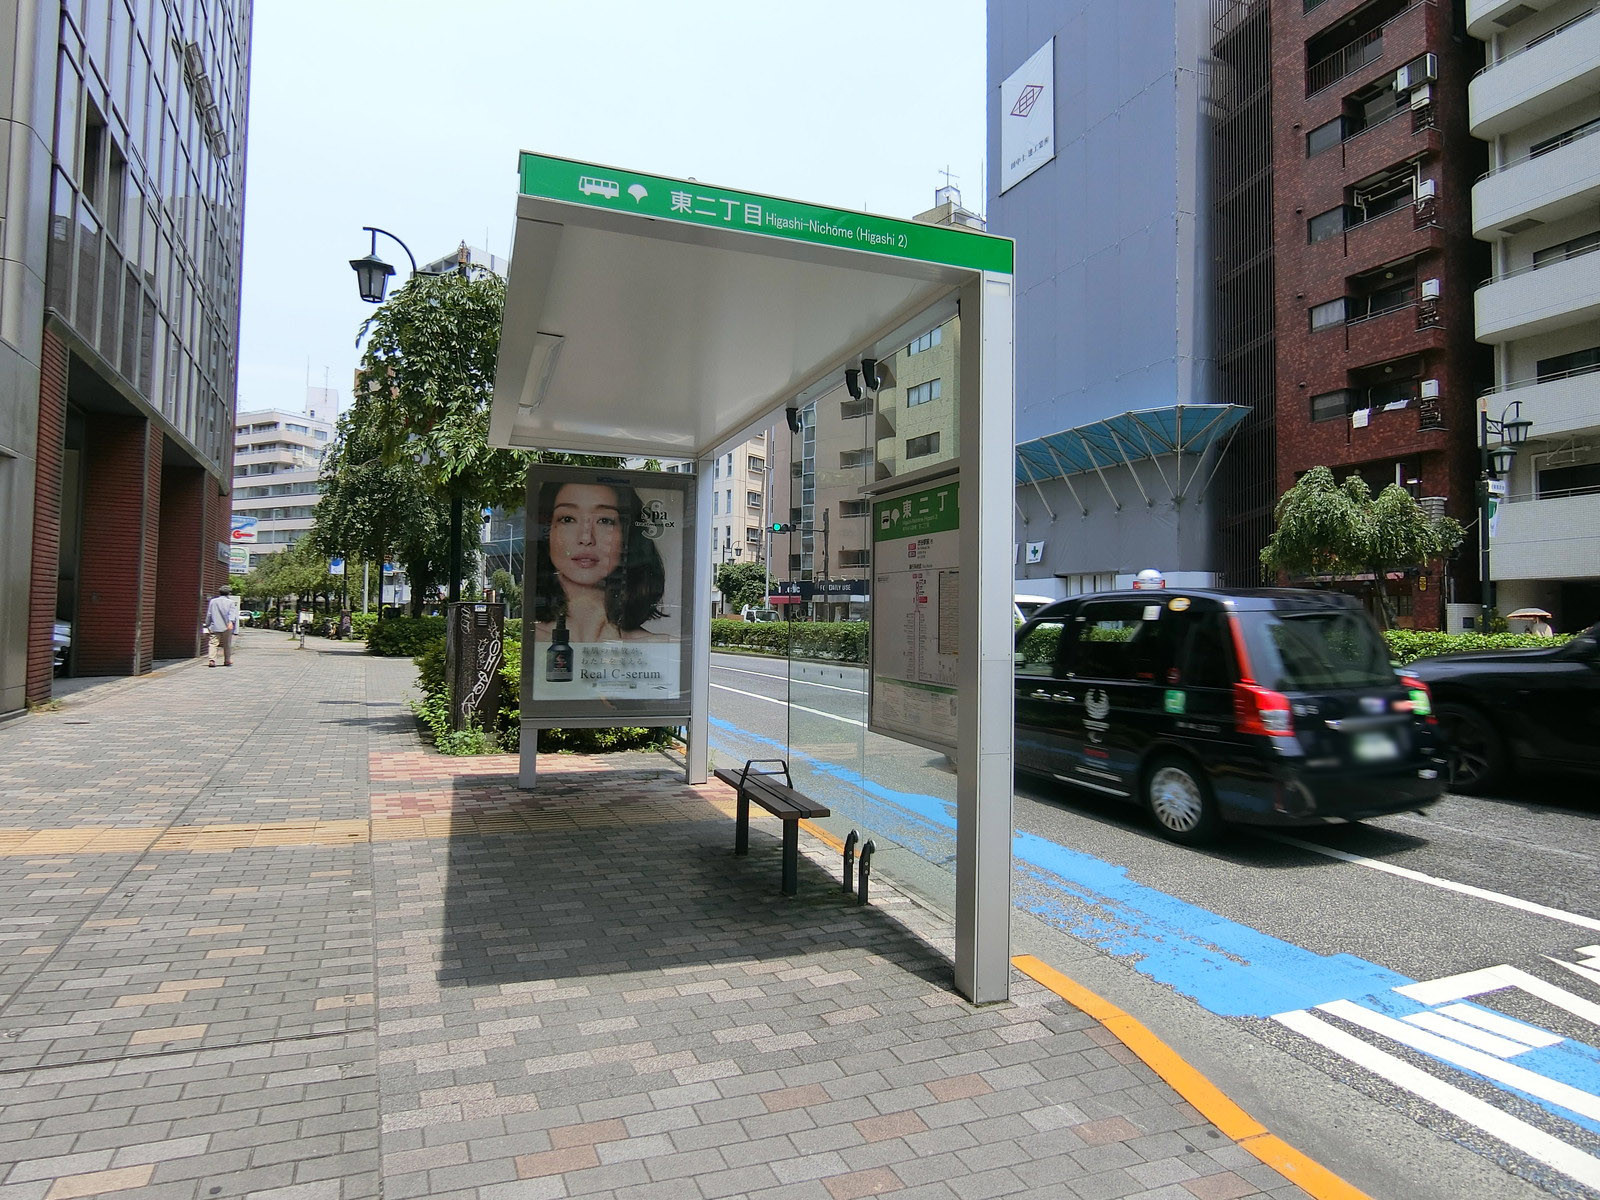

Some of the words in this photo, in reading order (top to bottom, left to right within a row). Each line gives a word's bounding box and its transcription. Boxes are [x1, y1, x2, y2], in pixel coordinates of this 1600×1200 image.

[670, 190, 762, 227] 東二丁目
[766, 211, 853, 239] Higashi-Nichōme
[856, 226, 895, 247] (Higashi
[898, 234, 908, 249] 2)
[641, 506, 668, 523] Spa
[902, 490, 960, 518] 東二丁
[580, 668, 606, 679] Real
[611, 668, 661, 679] C-serum
